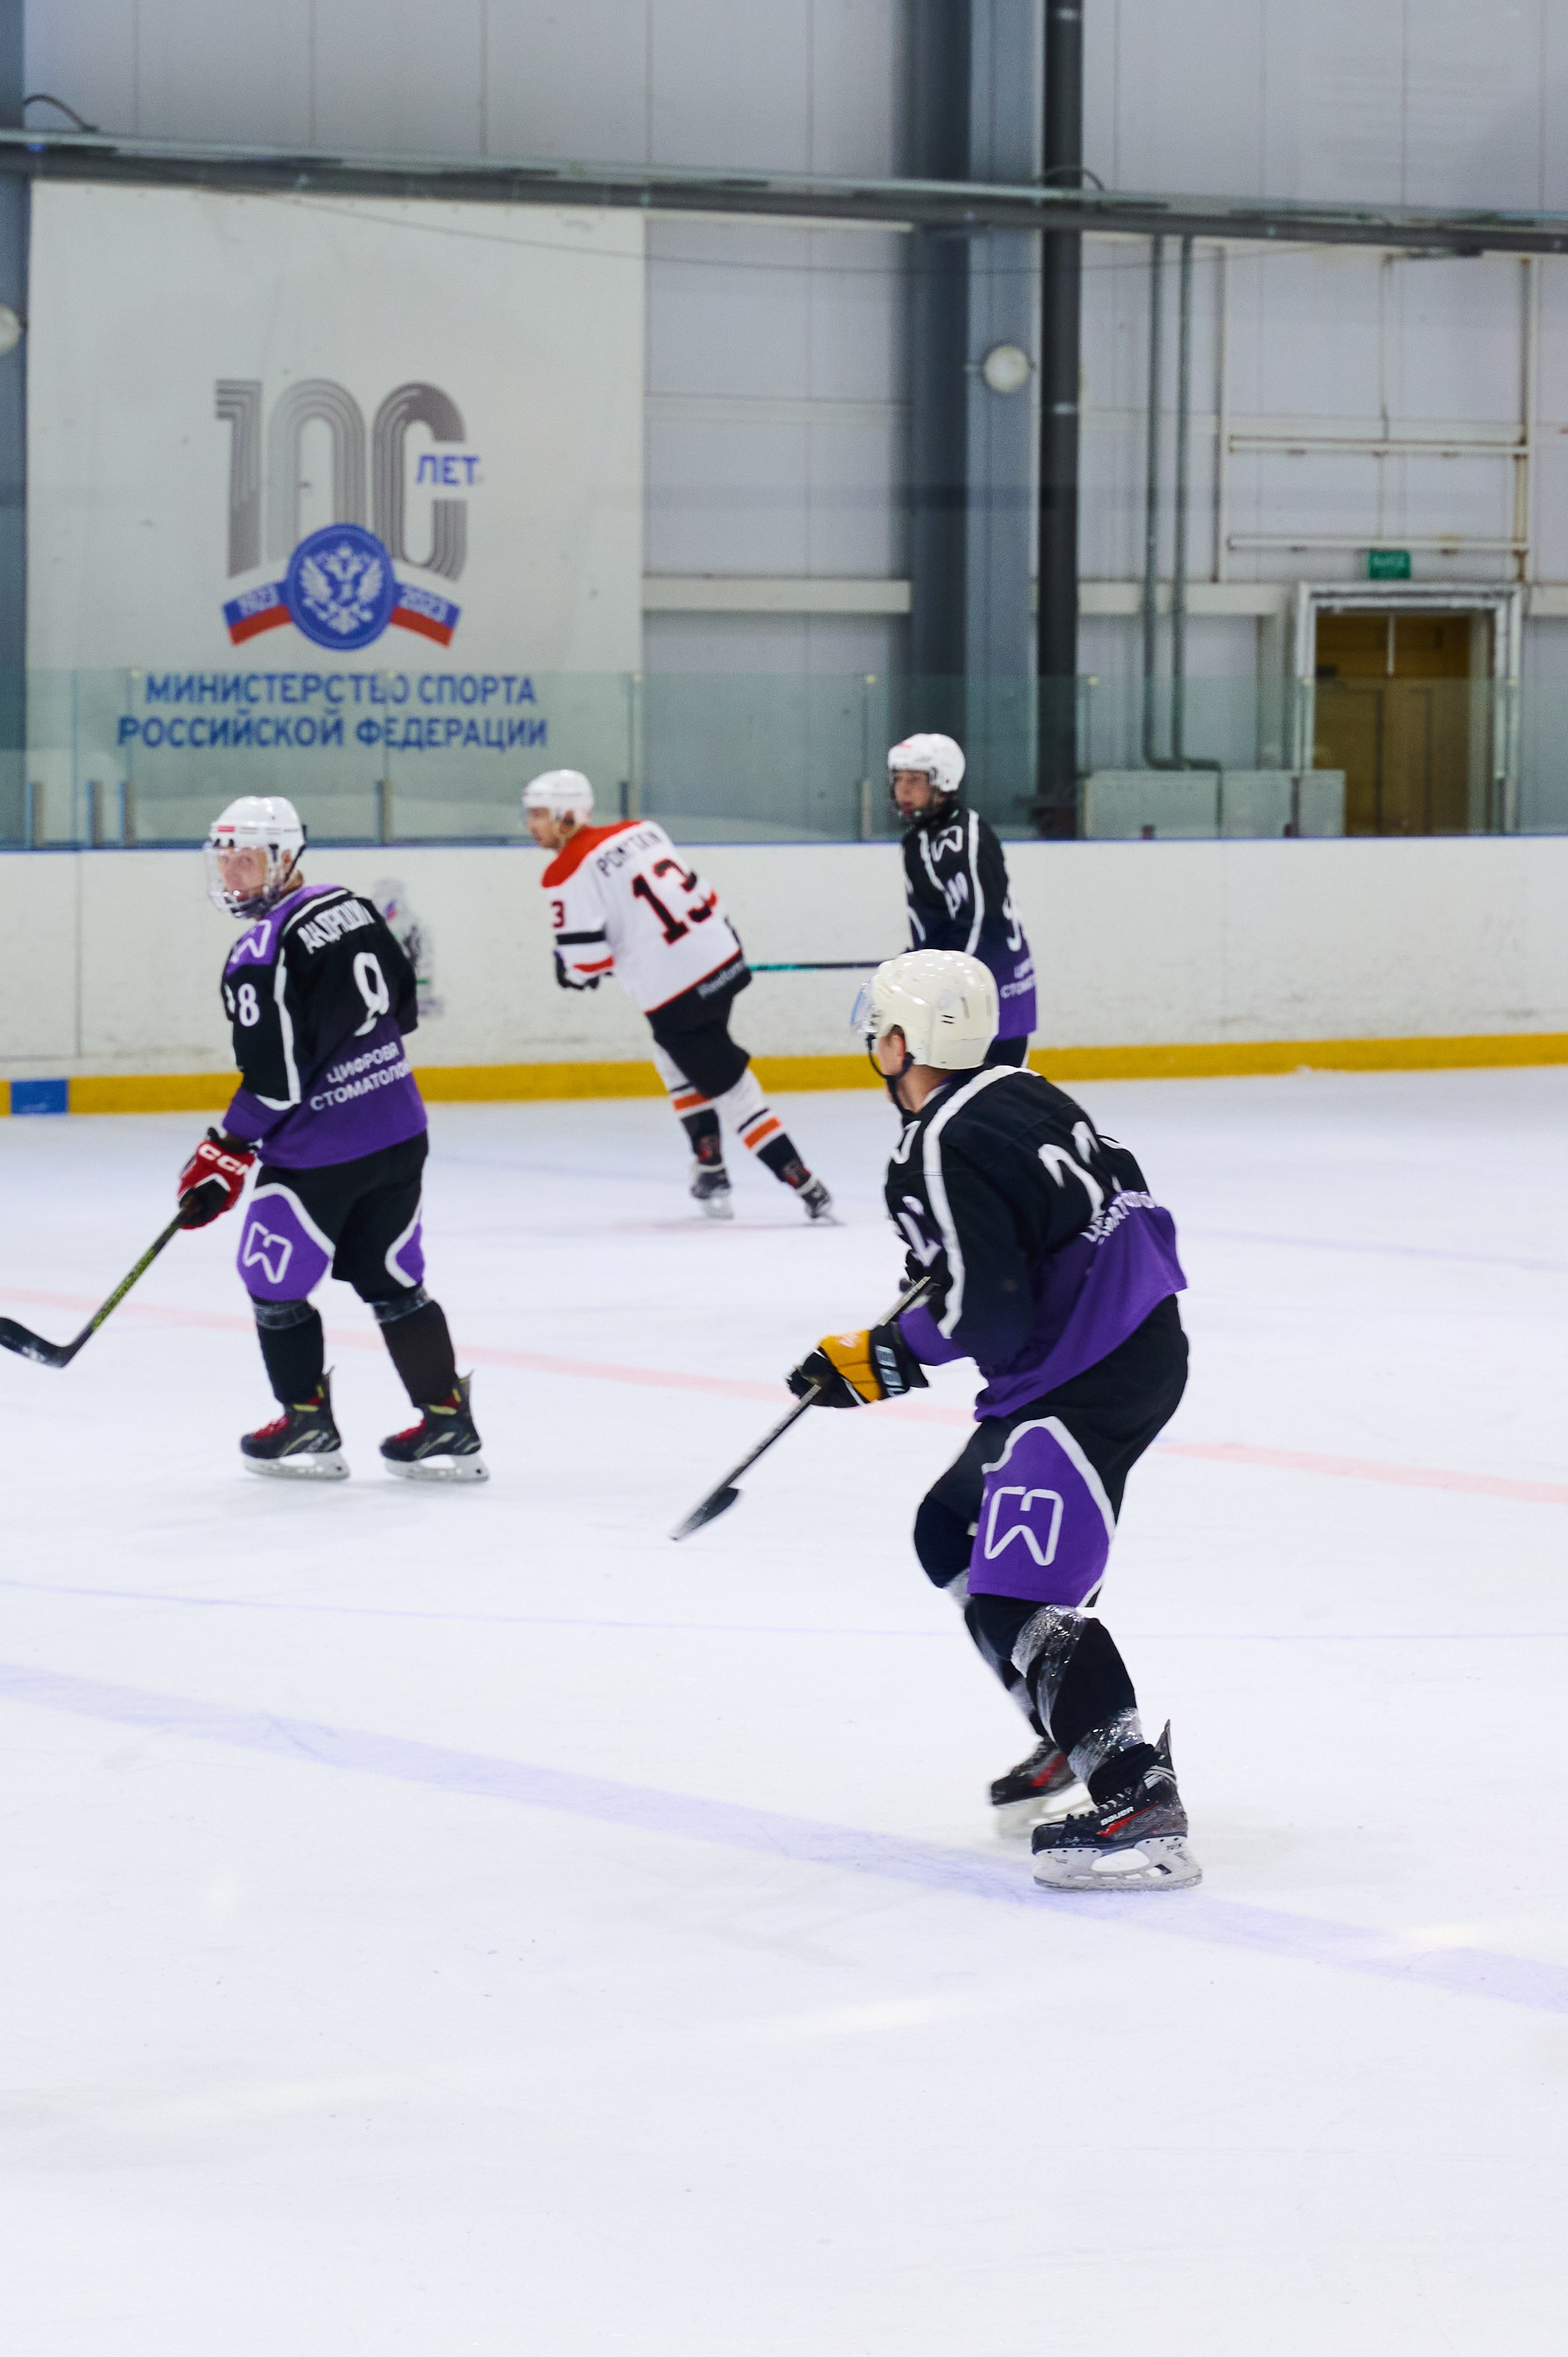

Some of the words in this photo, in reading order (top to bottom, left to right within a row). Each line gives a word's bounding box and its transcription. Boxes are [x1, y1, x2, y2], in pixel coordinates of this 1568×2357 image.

[416, 454, 480, 486] ЛЕТ
[145, 673, 410, 705] МИНИСТЕРСТВО
[417, 673, 538, 705] СПОРТА
[116, 708, 344, 748] РОССИЙСКОЙ
[355, 717, 549, 752] ФЕДЕРАЦИИ
[631, 857, 718, 946] 13
[1100, 1806, 1135, 1826] BAUER
